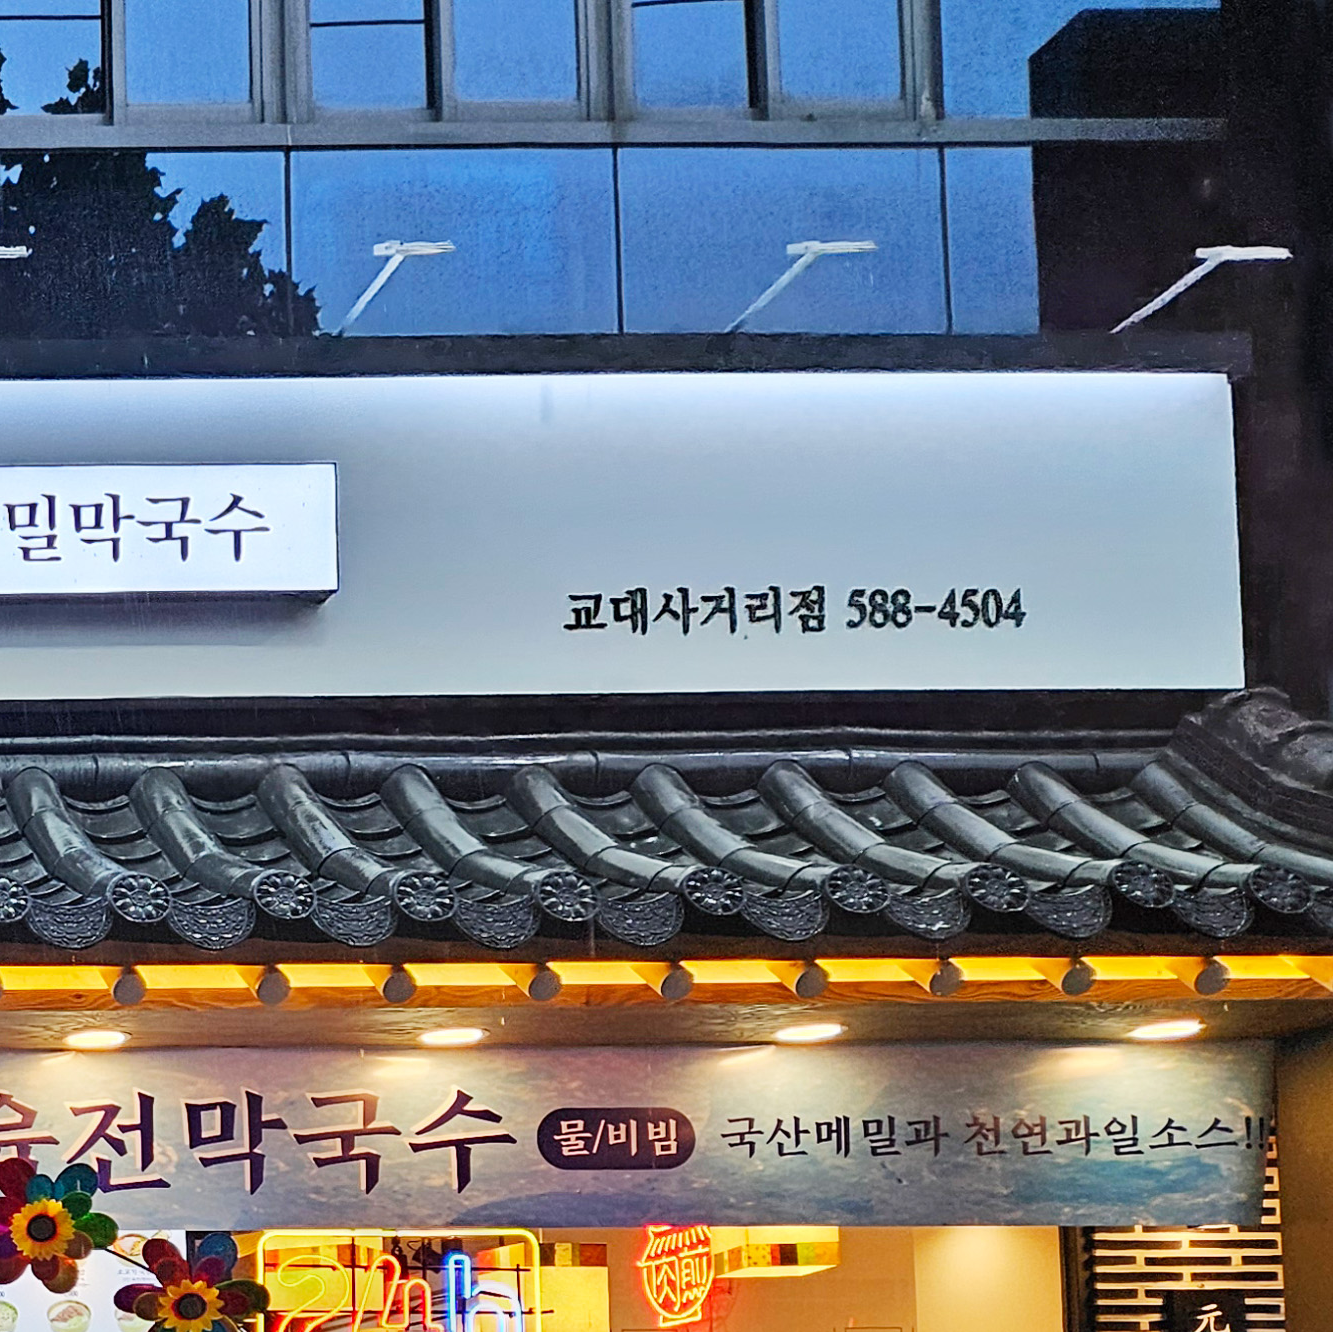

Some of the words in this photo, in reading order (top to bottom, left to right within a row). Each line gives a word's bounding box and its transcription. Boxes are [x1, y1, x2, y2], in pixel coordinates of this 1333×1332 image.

[563, 586, 827, 636] 교대사거리점
[846, 588, 1027, 629] 588-4504
[552, 1117, 680, 1157] 물/비빔
[720, 1114, 949, 1159] 국산메밀과
[962, 1114, 1271, 1158] 천연과일소스!!
